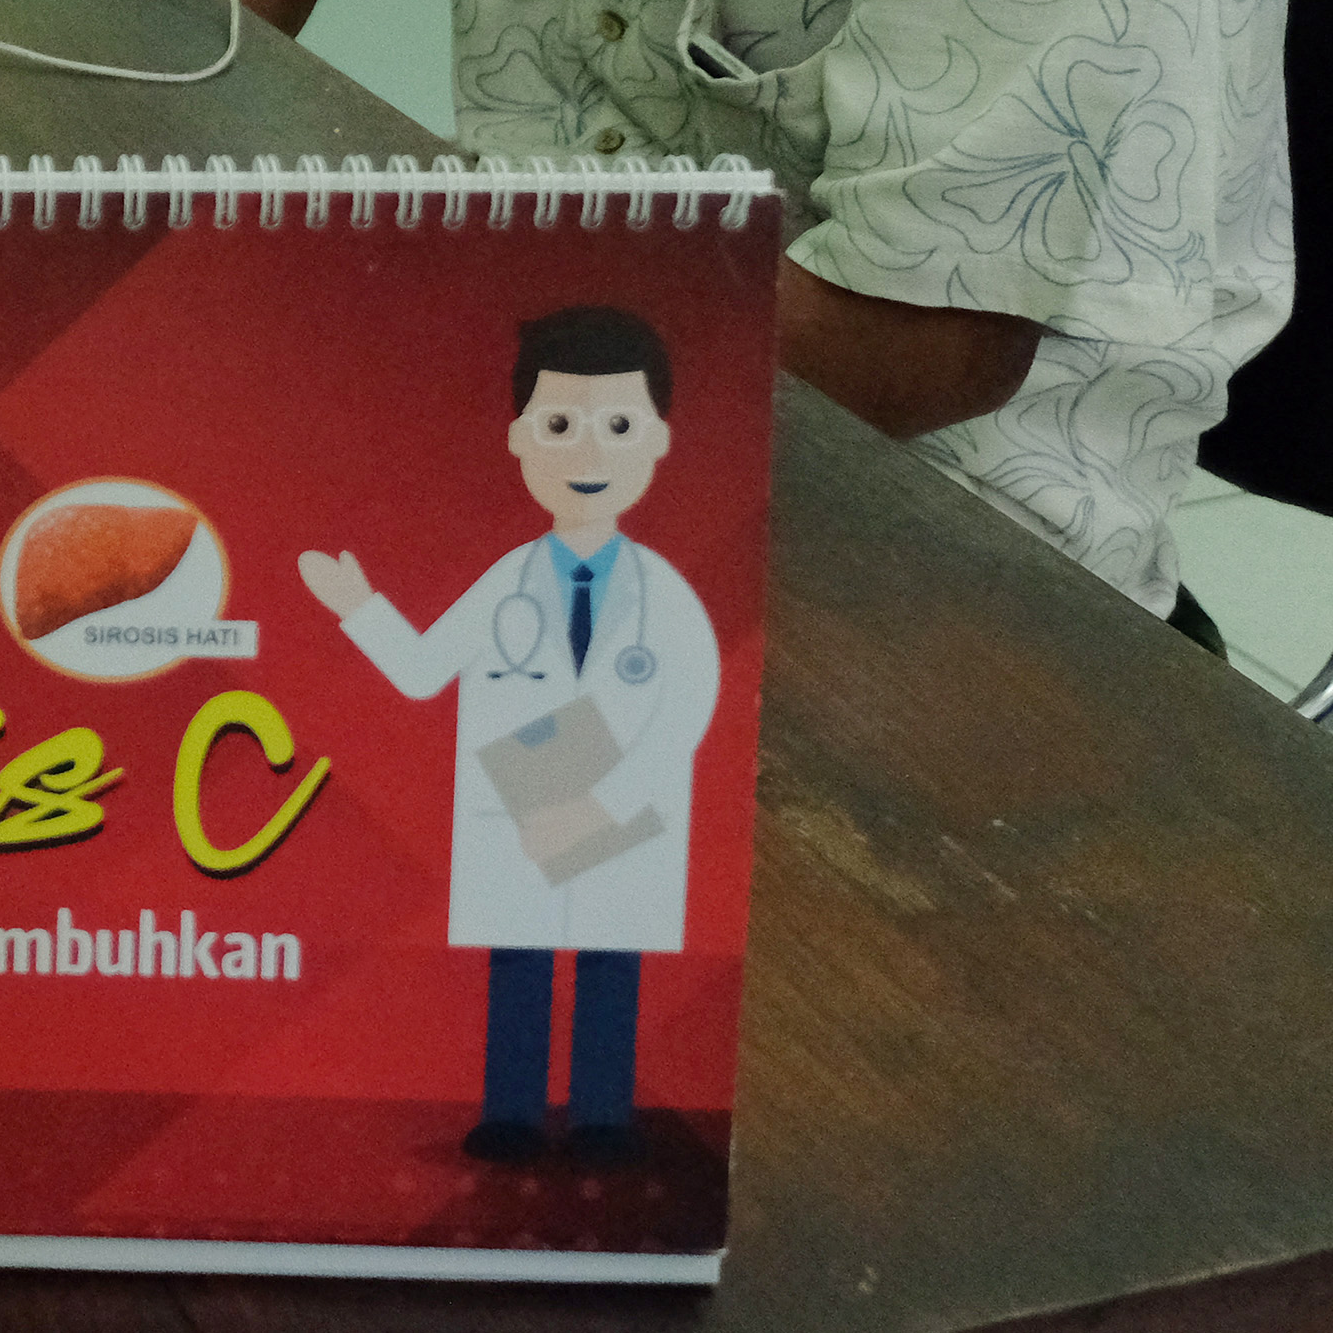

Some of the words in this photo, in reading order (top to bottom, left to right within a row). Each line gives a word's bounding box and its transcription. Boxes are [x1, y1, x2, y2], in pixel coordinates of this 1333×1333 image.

[84, 625, 179, 646] SIROSIS
[186, 627, 239, 646] HATI
[172, 689, 332, 872] C
